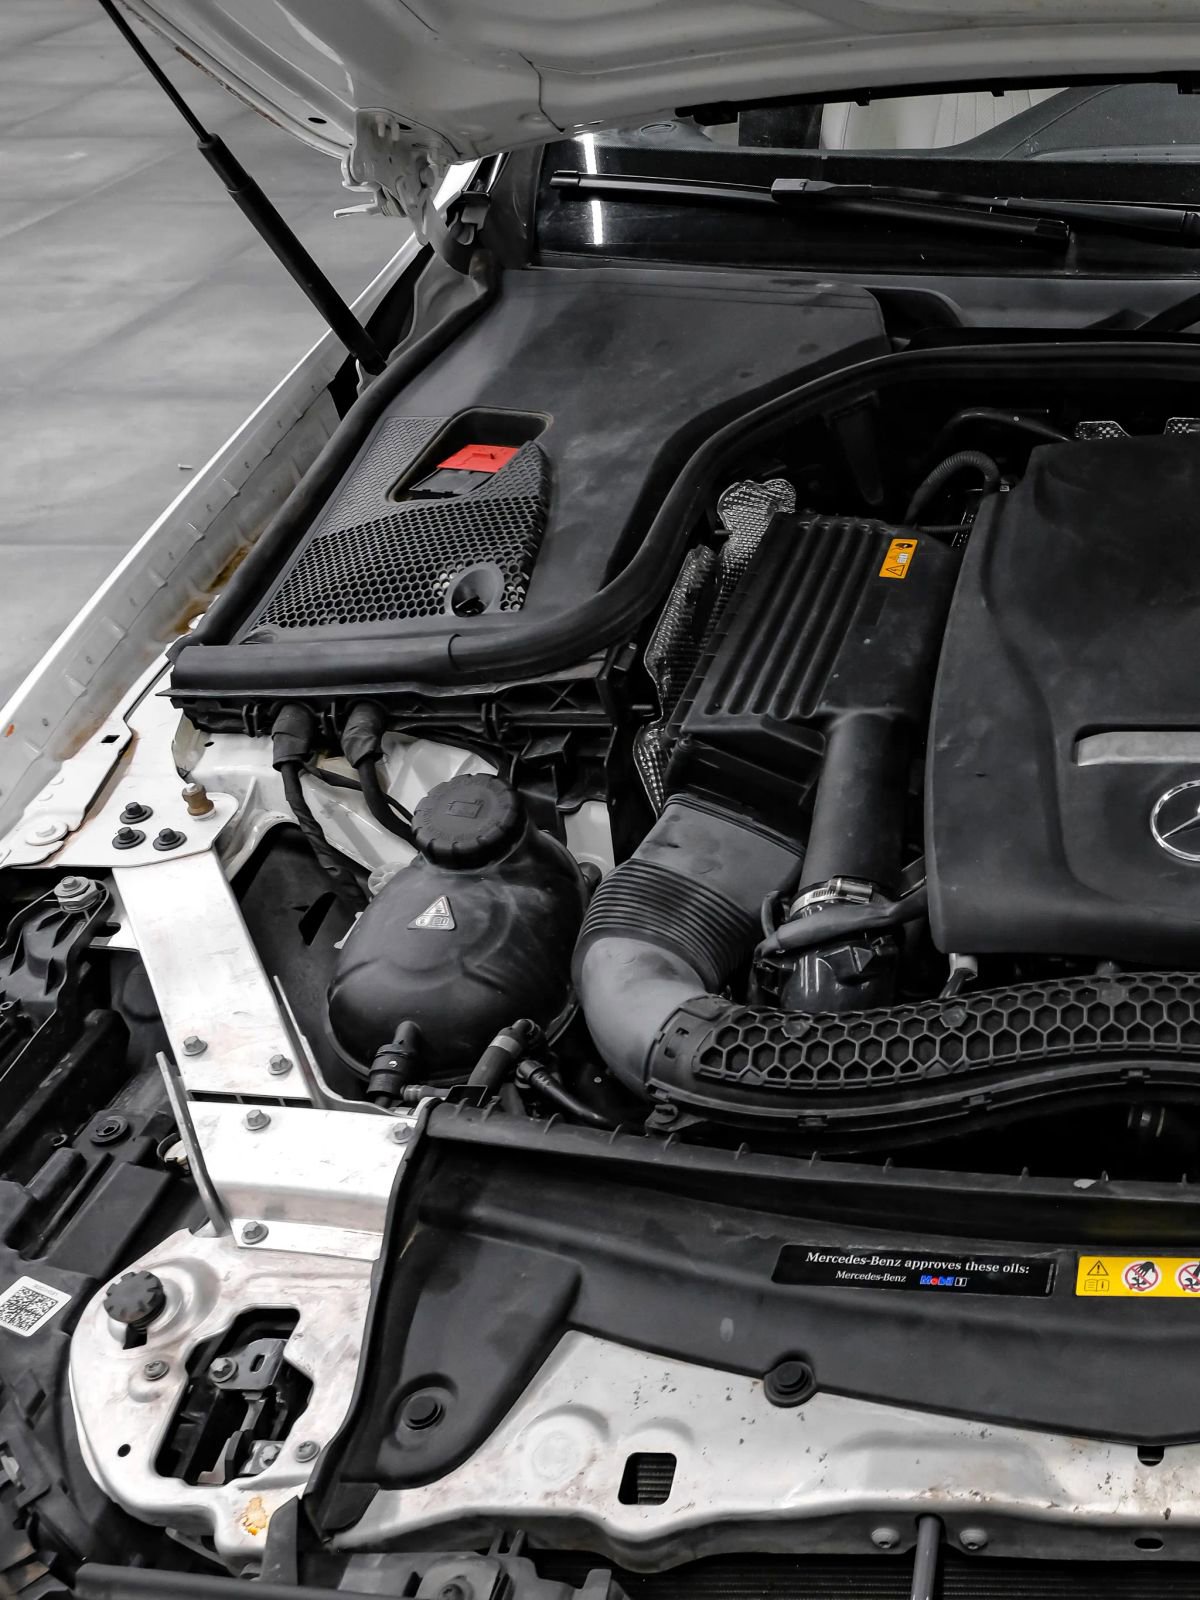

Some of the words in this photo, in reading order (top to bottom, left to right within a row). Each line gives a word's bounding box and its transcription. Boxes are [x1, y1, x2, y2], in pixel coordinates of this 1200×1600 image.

[805, 1252, 902, 1267] Mercedes-Benz
[904, 1259, 962, 1271] approves
[965, 1261, 1000, 1273] these
[1002, 1263, 1030, 1274] oils:
[835, 1270, 907, 1282] Mercedes-Benz
[920, 1275, 954, 1286] Mobil
